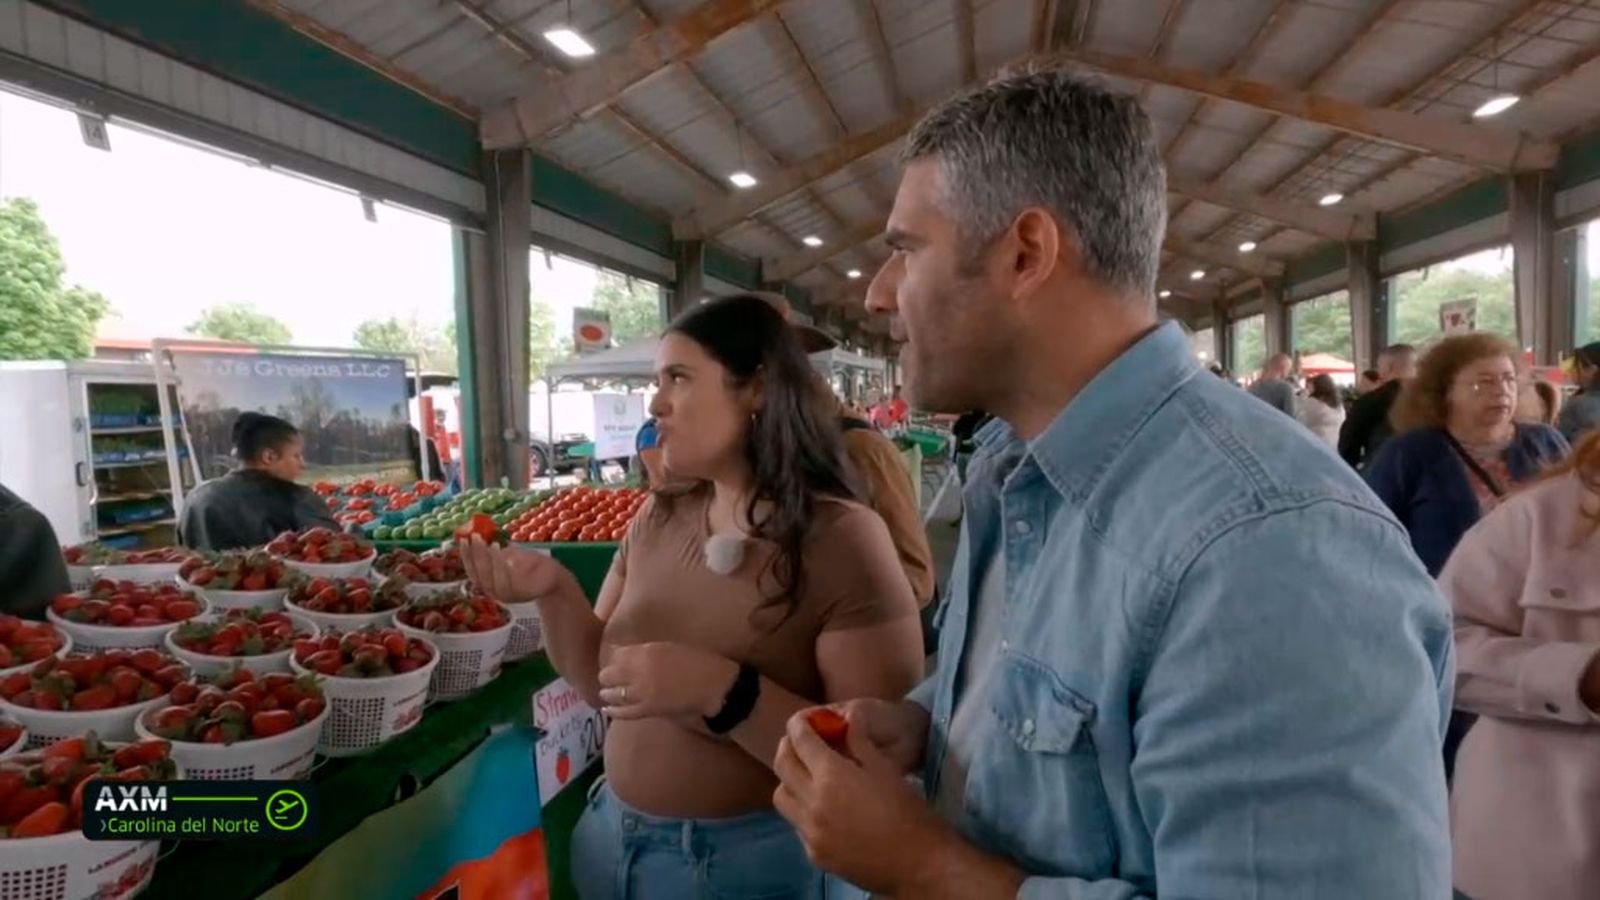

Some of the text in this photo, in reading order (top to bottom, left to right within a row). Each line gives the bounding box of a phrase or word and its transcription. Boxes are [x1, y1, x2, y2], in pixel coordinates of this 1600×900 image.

[254, 359, 342, 377] Greens
[347, 363, 391, 379] LLC
[536, 688, 579, 728] Straw
